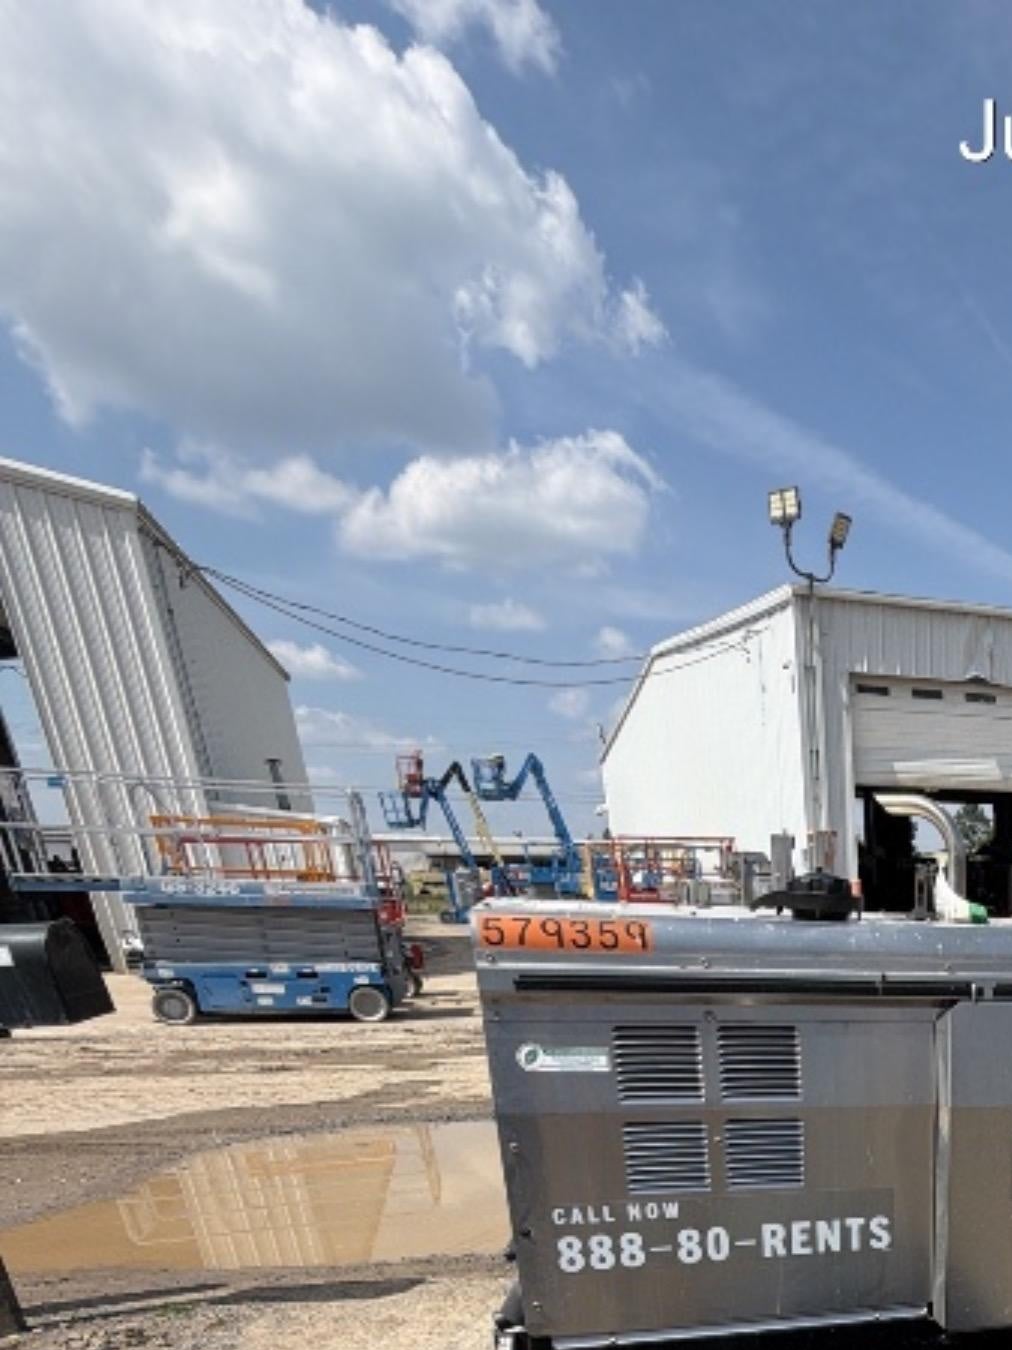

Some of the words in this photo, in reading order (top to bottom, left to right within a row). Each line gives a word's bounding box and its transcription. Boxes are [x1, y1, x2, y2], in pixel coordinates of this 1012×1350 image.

[482, 917, 649, 951] 579359
[552, 1204, 616, 1225] CALL
[626, 1201, 680, 1222] NOW
[556, 1214, 893, 1274] 888-80-RENTS
